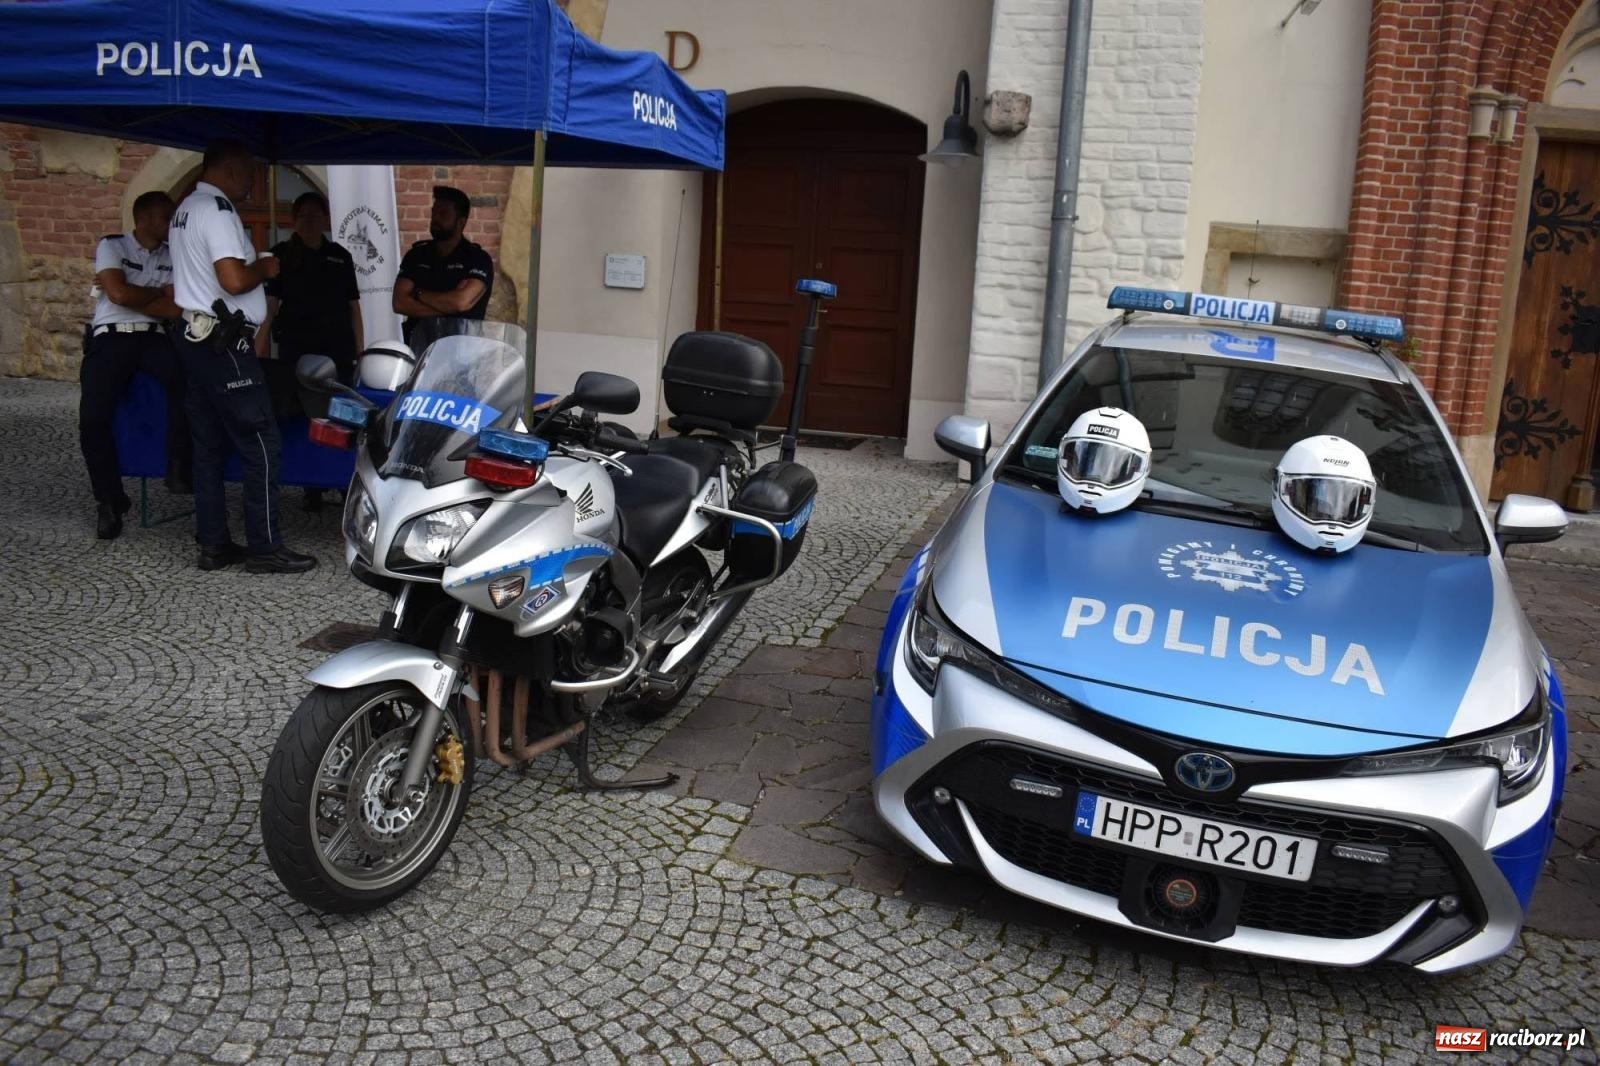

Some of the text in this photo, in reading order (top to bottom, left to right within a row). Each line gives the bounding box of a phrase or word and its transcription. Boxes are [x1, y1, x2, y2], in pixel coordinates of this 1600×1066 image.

[96, 41, 263, 78] POLICJA
[664, 31, 700, 71] D
[633, 90, 677, 131] POLICJA
[1193, 297, 1270, 322] POLICJA
[396, 395, 482, 433] POLICJA
[1089, 425, 1118, 437] POLICJA
[576, 508, 605, 523] HONDA
[1158, 541, 1213, 578] POMAGAMY
[1252, 549, 1305, 597] CHRONIMY
[1200, 555, 1263, 569] POLICJA
[1220, 571, 1243, 581] 112
[1061, 596, 1385, 696] POLICJA
[1076, 817, 1091, 829] PL
[1101, 802, 1300, 875] HPP R201
